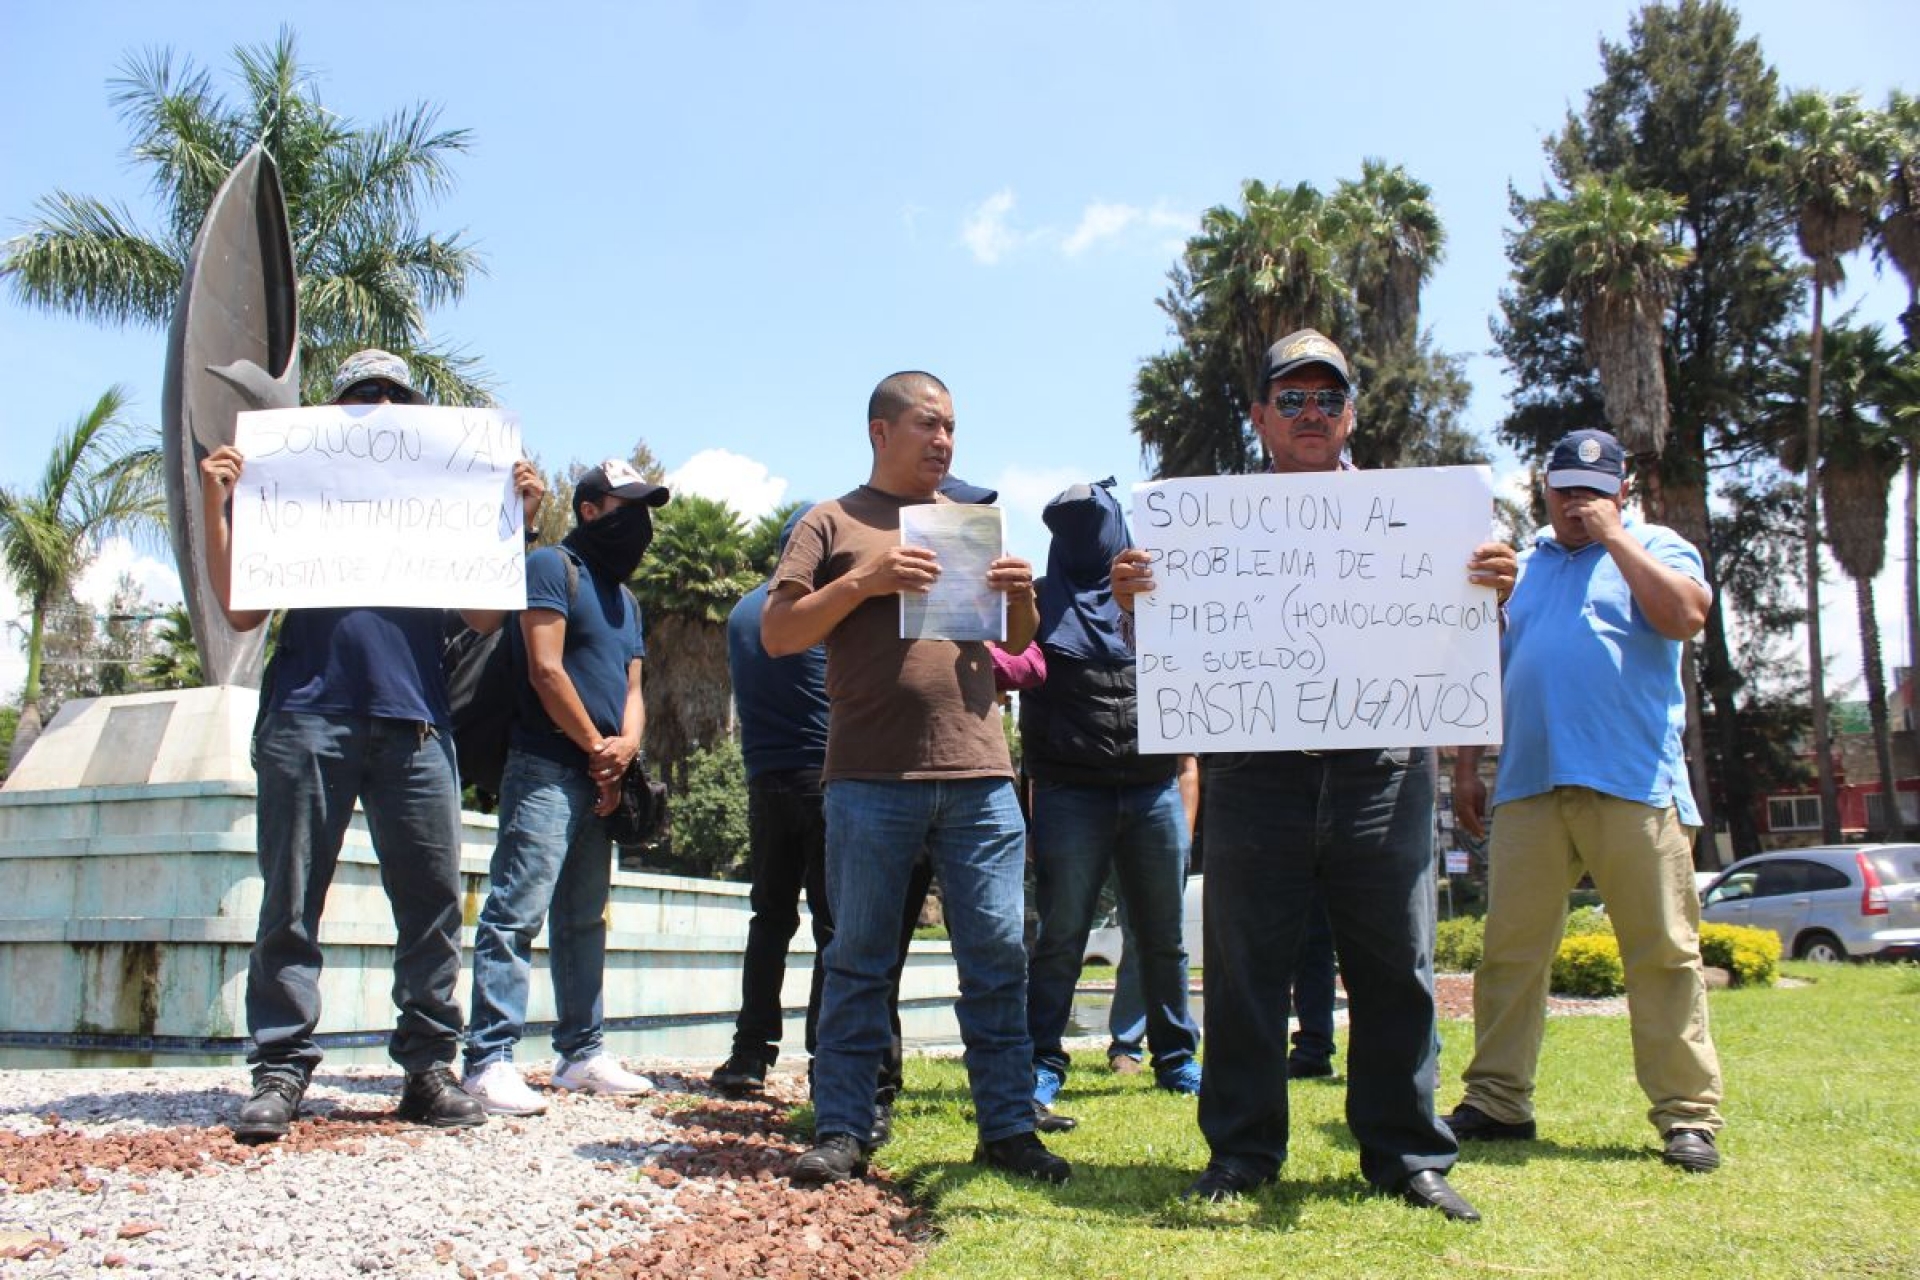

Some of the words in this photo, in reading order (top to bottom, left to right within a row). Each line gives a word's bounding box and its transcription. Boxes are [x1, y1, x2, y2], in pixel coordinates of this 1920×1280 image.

[251, 423, 422, 463] SOLUCION
[319, 491, 520, 537] INTIMIDACION
[1146, 491, 1342, 533] SOLUCION
[1364, 496, 1408, 534] AL
[239, 552, 327, 592] BASTA
[1144, 546, 1316, 581] PROBLEMA
[1336, 549, 1376, 580] DE
[1399, 552, 1434, 581] LA
[1281, 583, 1497, 642] (HOMOLOGACION
[1140, 653, 1182, 674] DE
[1202, 631, 1326, 676] SUELDO)
[1156, 681, 1276, 740] BASTA
